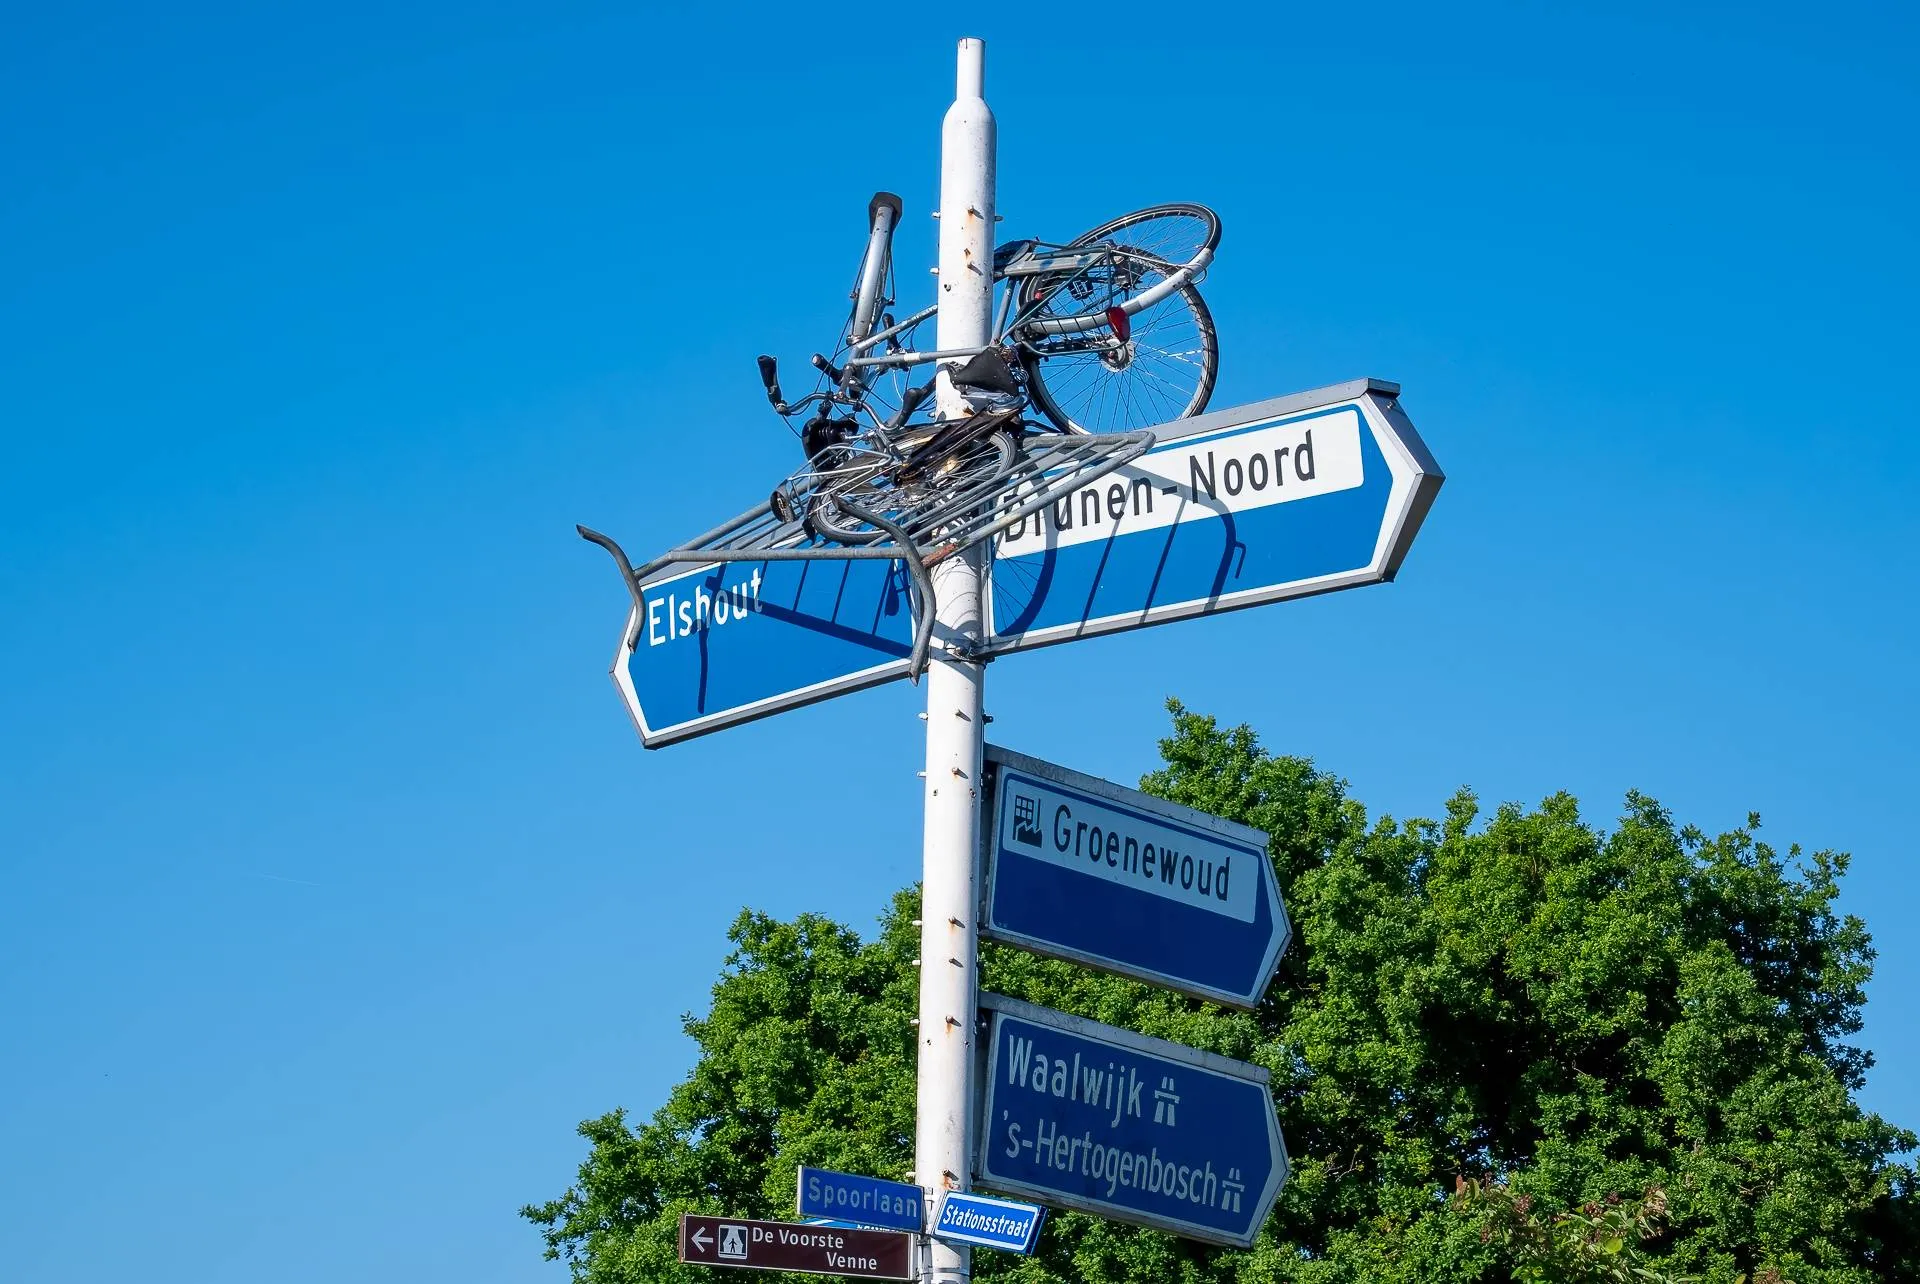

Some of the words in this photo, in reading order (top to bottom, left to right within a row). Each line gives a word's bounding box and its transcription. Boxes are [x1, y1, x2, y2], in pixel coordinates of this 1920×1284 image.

[649, 567, 763, 647] Elshout
[1053, 804, 1231, 902] Groenewoud
[1008, 1034, 1145, 1129] Waalwijk
[1002, 1110, 1217, 1208] 's-Hertogenbosch
[808, 1176, 918, 1219] Spoorlaan
[942, 1204, 1029, 1240] Stationsstraat
[752, 1227, 773, 1244] De
[778, 1229, 844, 1250] Voorste
[827, 1251, 878, 1271] Venne
